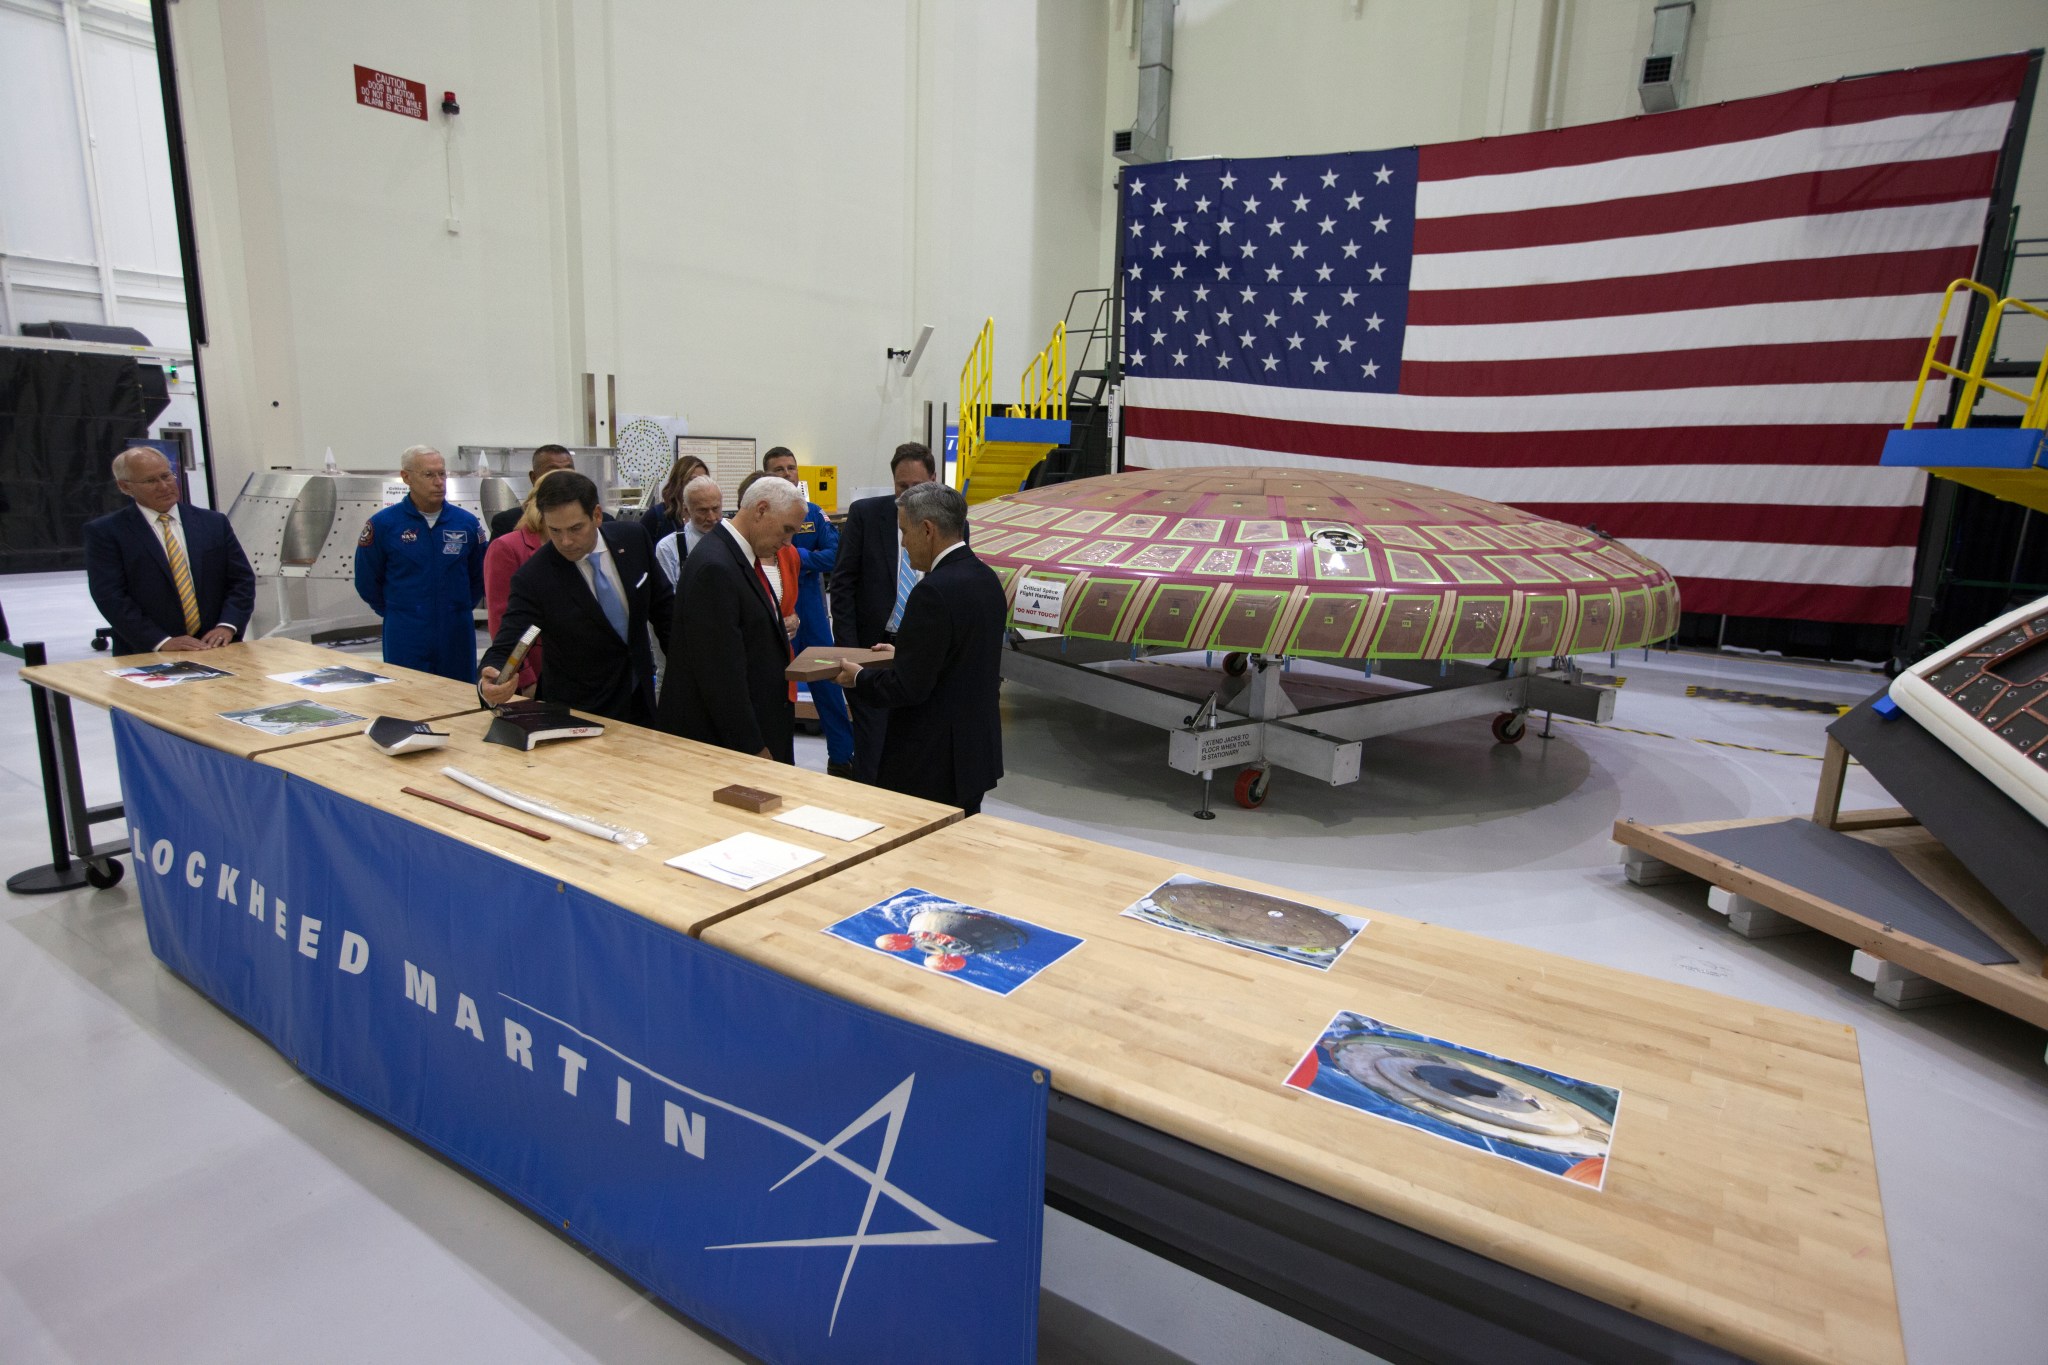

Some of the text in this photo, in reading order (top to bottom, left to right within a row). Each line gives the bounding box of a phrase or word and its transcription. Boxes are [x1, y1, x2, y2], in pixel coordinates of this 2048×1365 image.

[367, 80, 415, 99] DOOR IN MOTION
[375, 73, 407, 90] CAUTION
[361, 86, 422, 111] DO NOT ENTER WHILE
[365, 96, 421, 117] ALARM IS ACTIVATED
[1035, 592, 1059, 601] Hardware
[1220, 742, 1237, 751] WHEN
[1237, 740, 1251, 748] TOOL
[1223, 734, 1241, 744] JACKS
[1241, 733, 1250, 741] TO
[1207, 749, 1239, 760] STATIONARY
[133, 827, 706, 1160] LOCKHEED MARTIN
